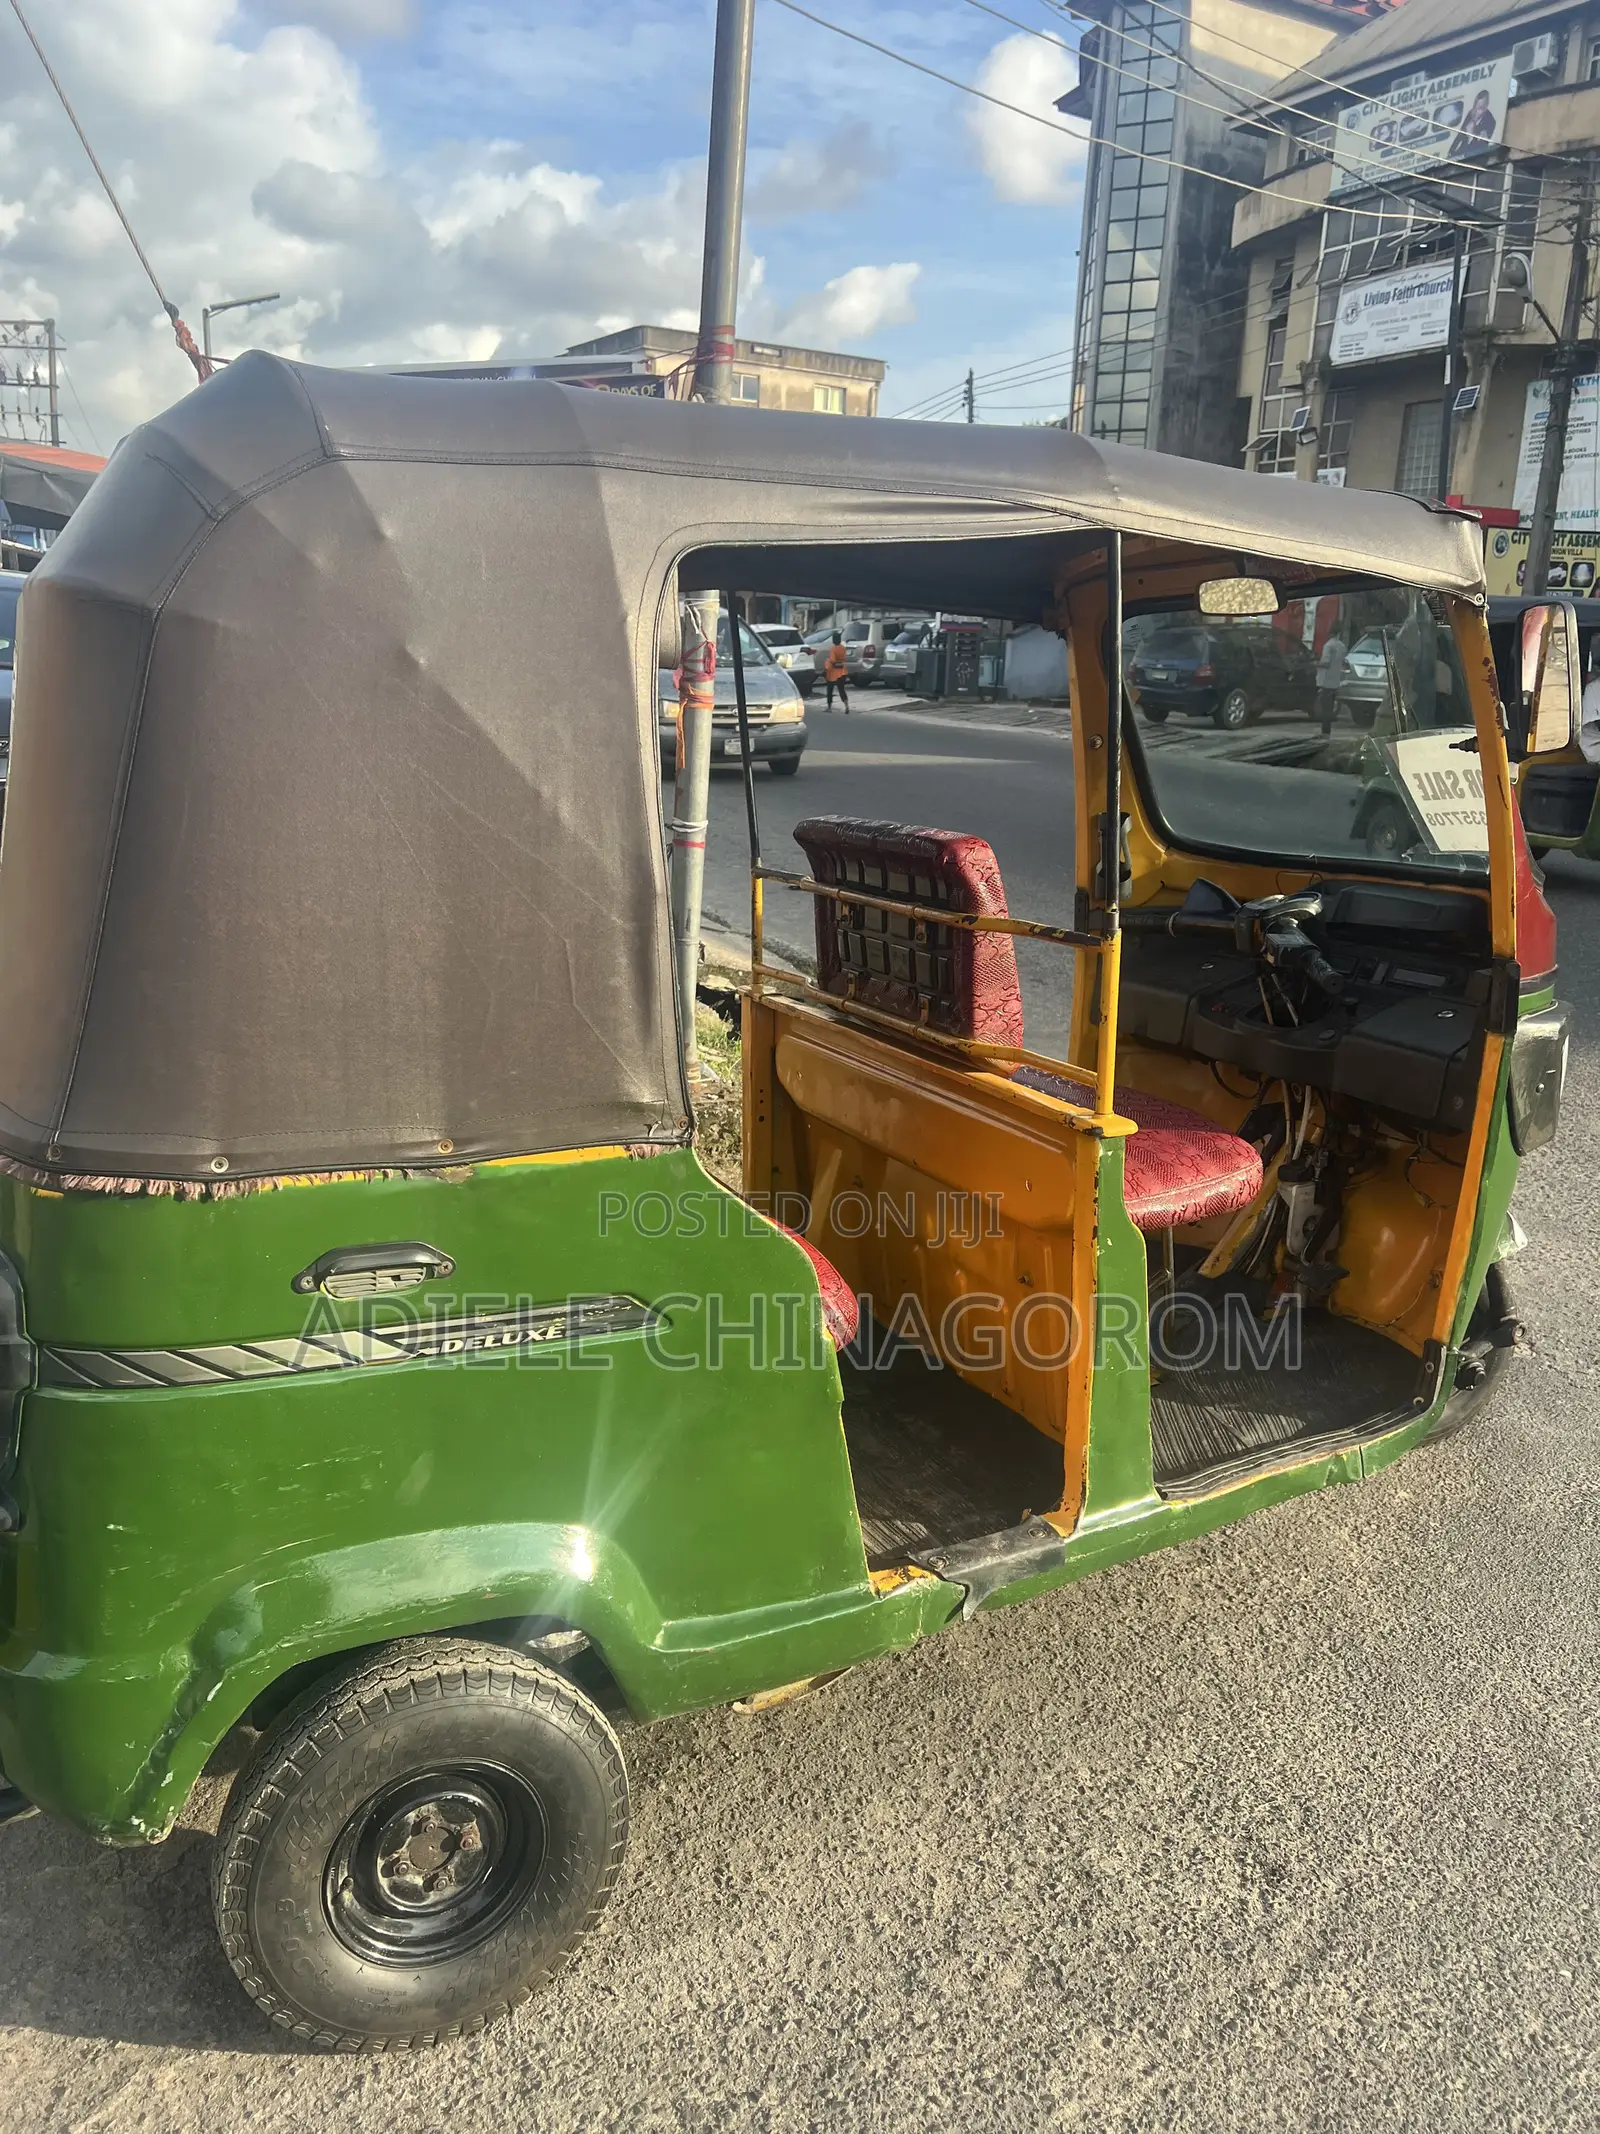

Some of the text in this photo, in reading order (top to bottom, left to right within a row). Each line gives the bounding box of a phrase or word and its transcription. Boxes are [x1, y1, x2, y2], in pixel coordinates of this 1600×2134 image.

[1362, 64, 1497, 116] CITY LIGHT ASSEMBLY
[1364, 288, 1392, 307] Living
[1392, 283, 1416, 302] Faith
[1417, 277, 1454, 297] Church
[641, 384, 657, 397] OF
[1570, 509, 1600, 519] HEALTH
[1511, 531, 1531, 546] CIT
[439, 1324, 567, 1355] DELUXE
